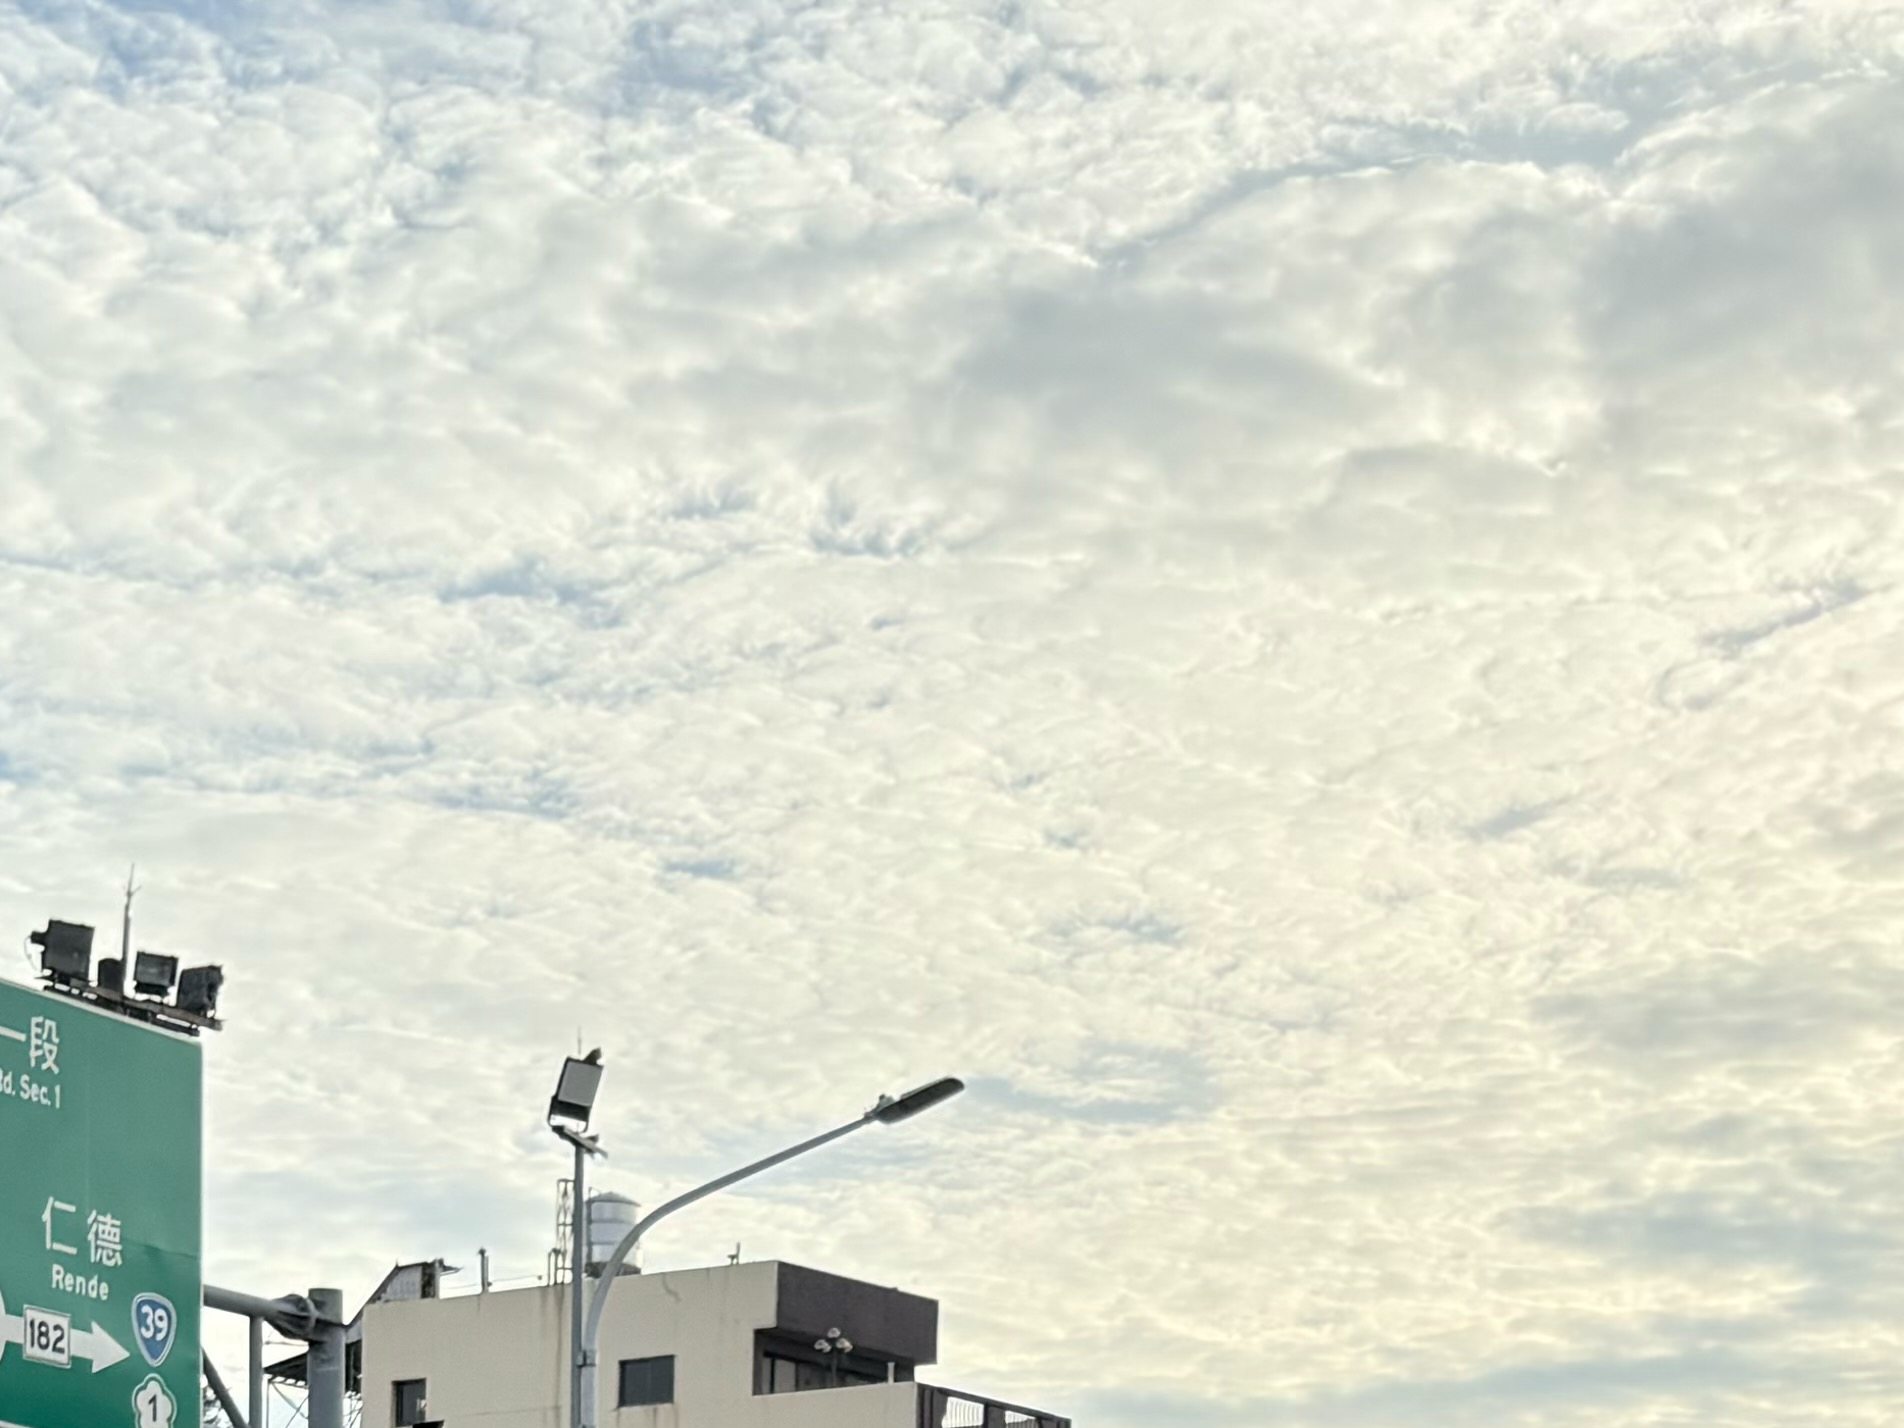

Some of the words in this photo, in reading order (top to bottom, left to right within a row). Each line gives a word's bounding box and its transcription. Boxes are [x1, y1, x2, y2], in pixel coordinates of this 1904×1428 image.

[19, 1076, 51, 1106] Sec.
[53, 1084, 62, 1109] 1
[41, 1195, 123, 1267] 仁德
[51, 1265, 110, 1301] Rende
[29, 1316, 66, 1355] 182
[139, 1308, 169, 1341] 39
[148, 1393, 158, 1423] 1
